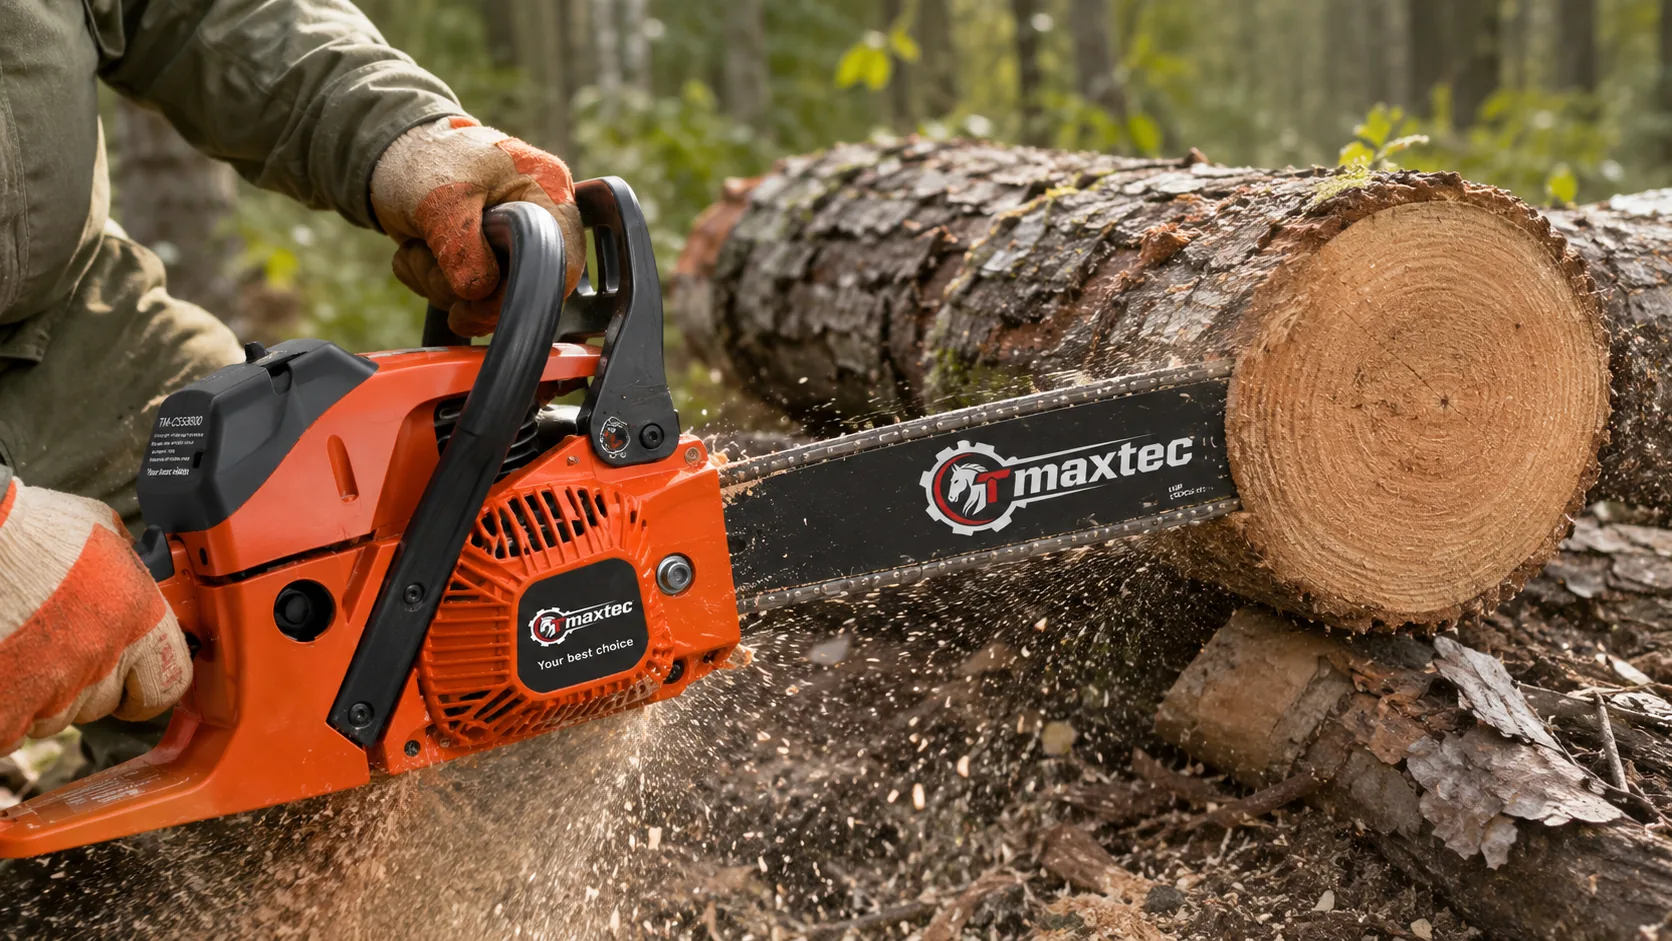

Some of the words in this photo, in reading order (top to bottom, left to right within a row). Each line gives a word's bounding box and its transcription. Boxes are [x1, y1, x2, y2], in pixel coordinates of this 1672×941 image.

[537, 657, 564, 670] Your
[567, 648, 593, 663] best
[596, 638, 634, 655] choice
